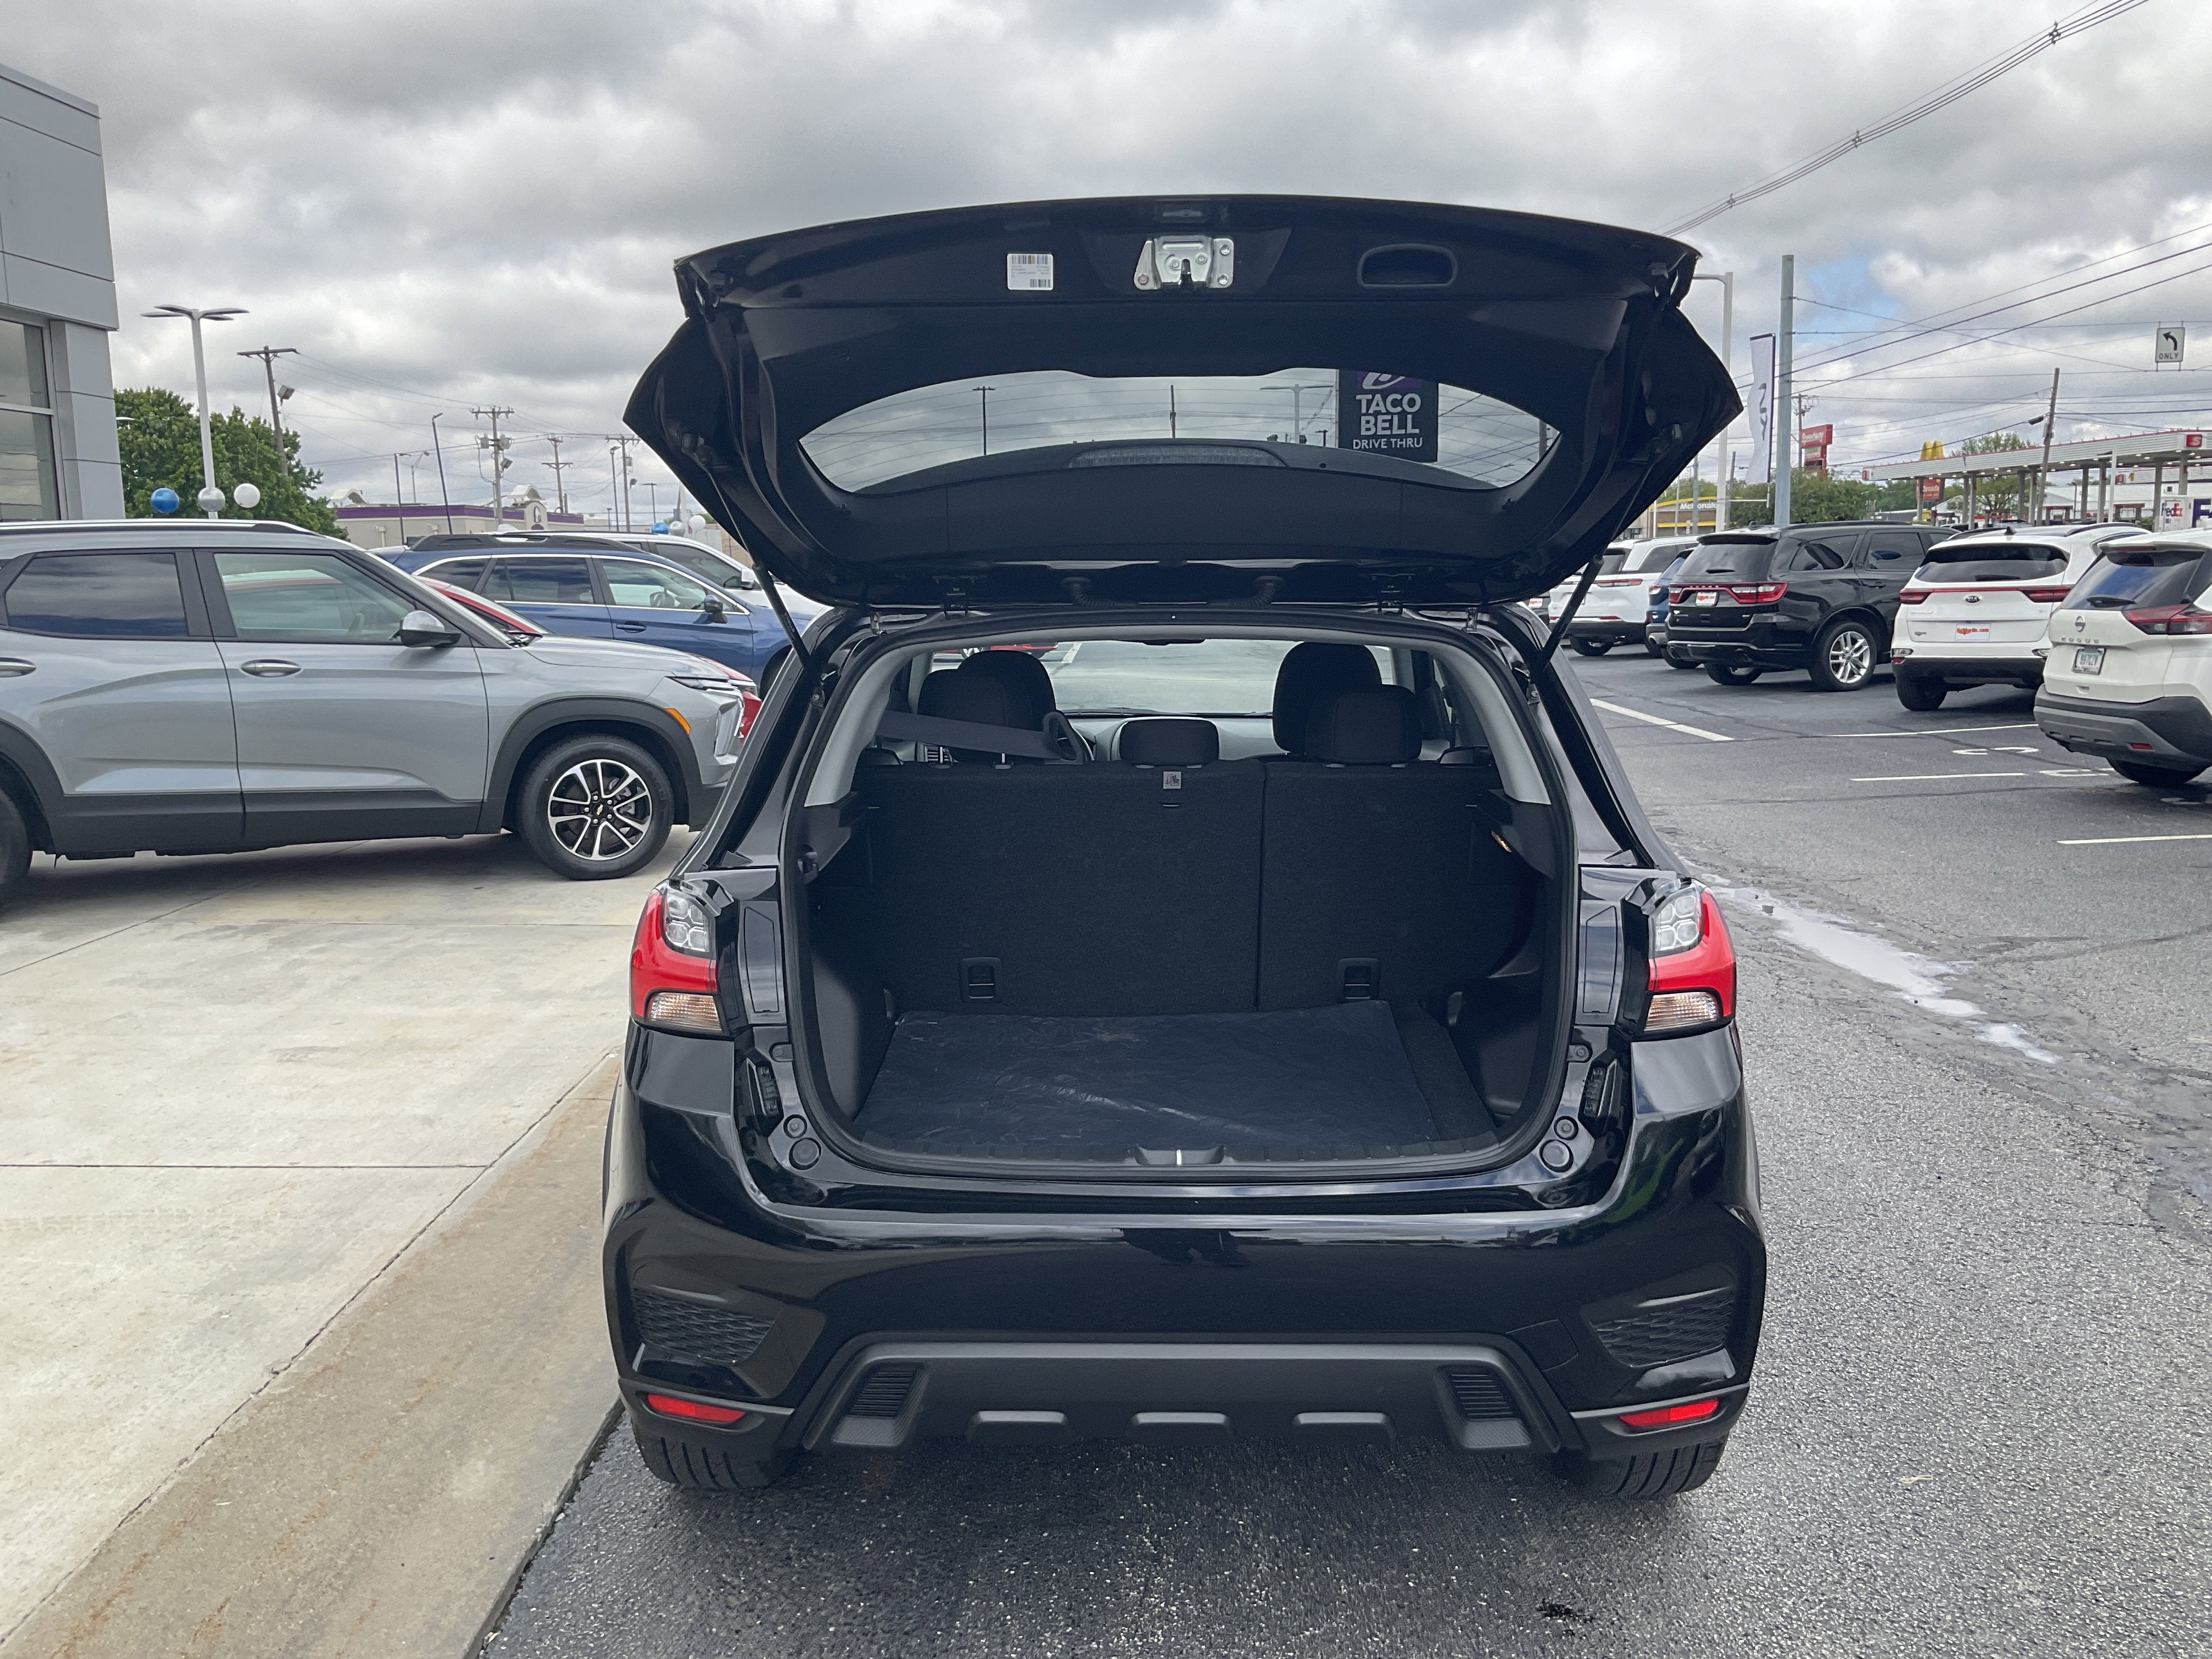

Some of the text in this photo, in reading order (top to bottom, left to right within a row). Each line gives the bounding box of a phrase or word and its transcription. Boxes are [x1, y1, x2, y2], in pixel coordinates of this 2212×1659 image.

[1356, 393, 1421, 413] TACO
[1361, 415, 1419, 435] BELL
[1353, 438, 1422, 449] DRIVE THRU
